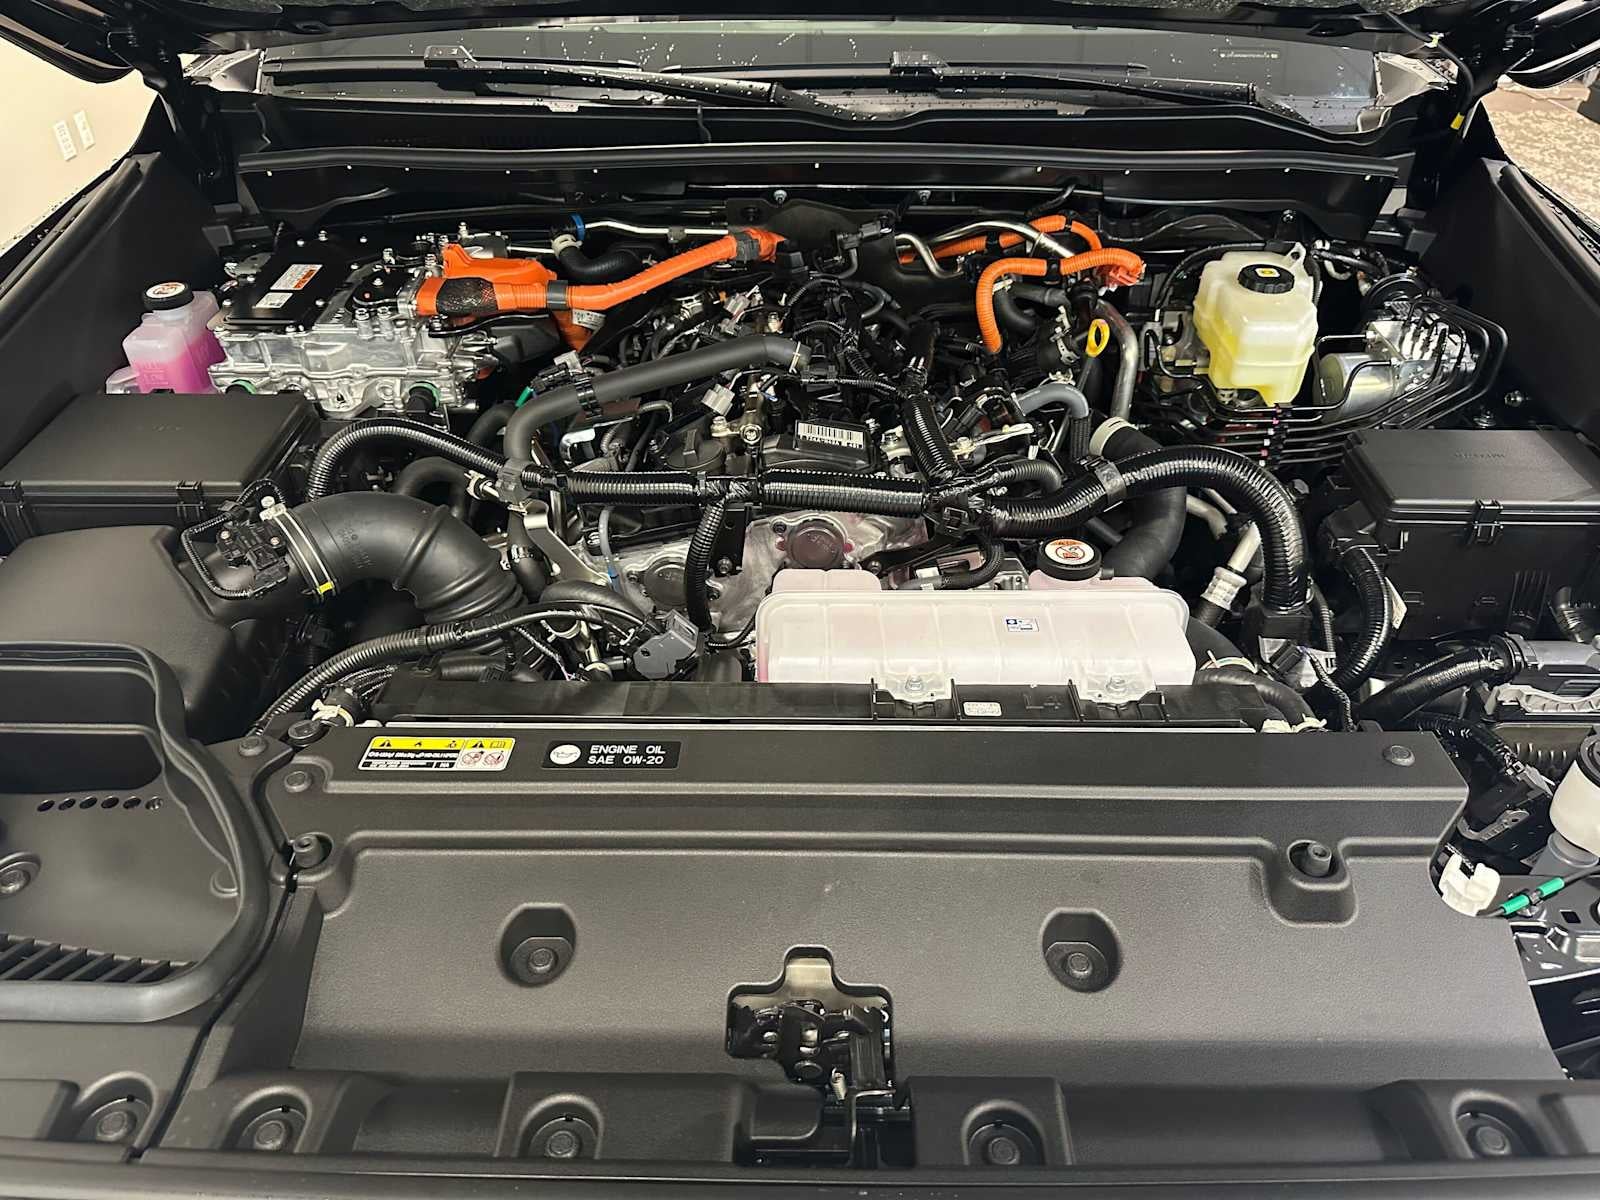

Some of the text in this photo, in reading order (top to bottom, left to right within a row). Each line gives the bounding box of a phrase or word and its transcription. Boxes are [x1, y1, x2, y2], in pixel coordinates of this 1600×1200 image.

[589, 744, 667, 755] ENGINE OIL
[587, 755, 665, 765] SAE 0W-20
